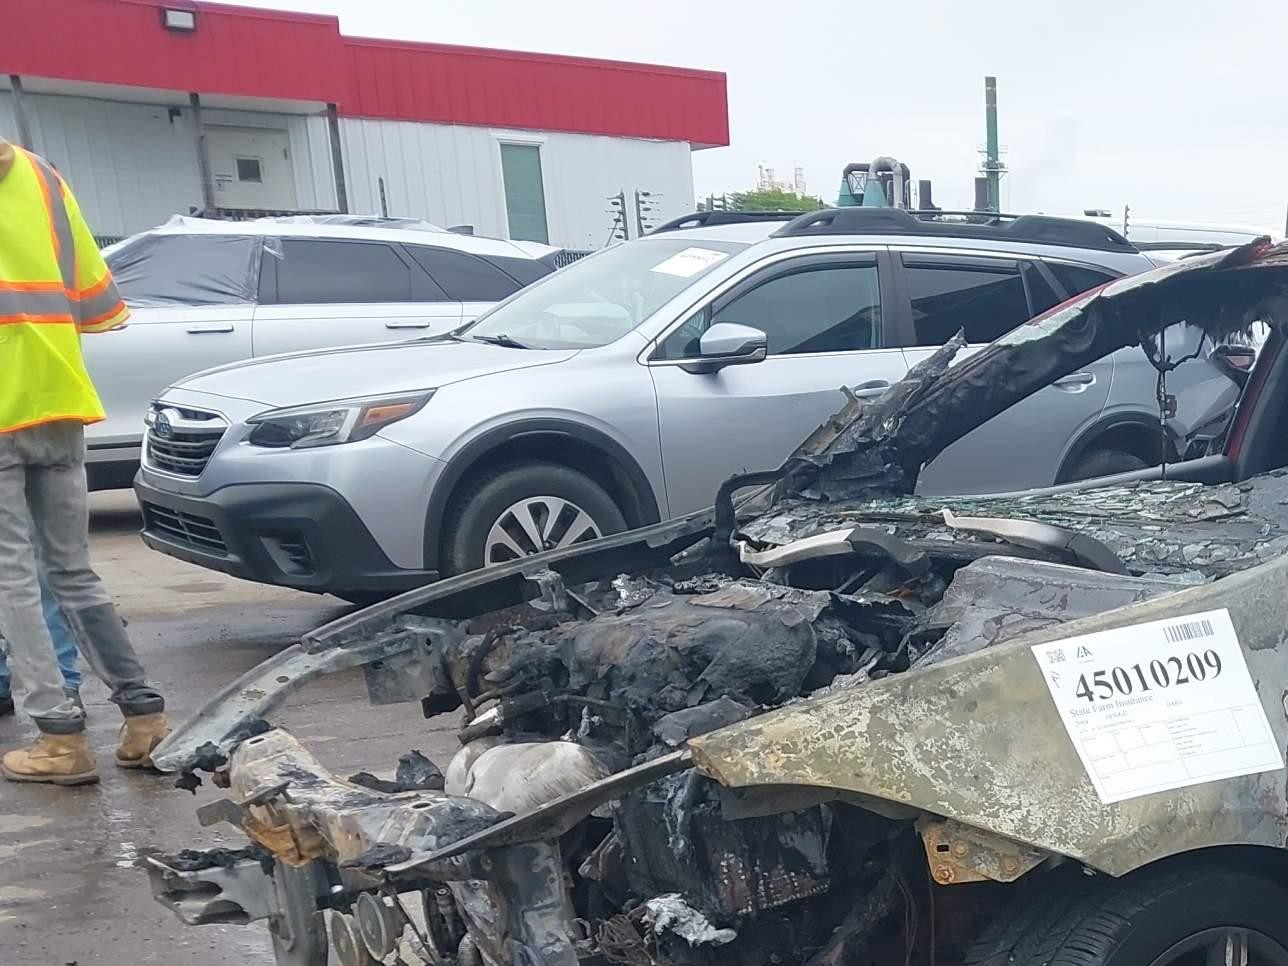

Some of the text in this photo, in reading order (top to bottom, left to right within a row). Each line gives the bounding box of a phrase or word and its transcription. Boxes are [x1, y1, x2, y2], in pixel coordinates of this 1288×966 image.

[1075, 649, 1222, 703] 45010209
[1069, 707, 1091, 719] State
[1092, 702, 1115, 714] Farm
[1115, 695, 1153, 710] Insurance
